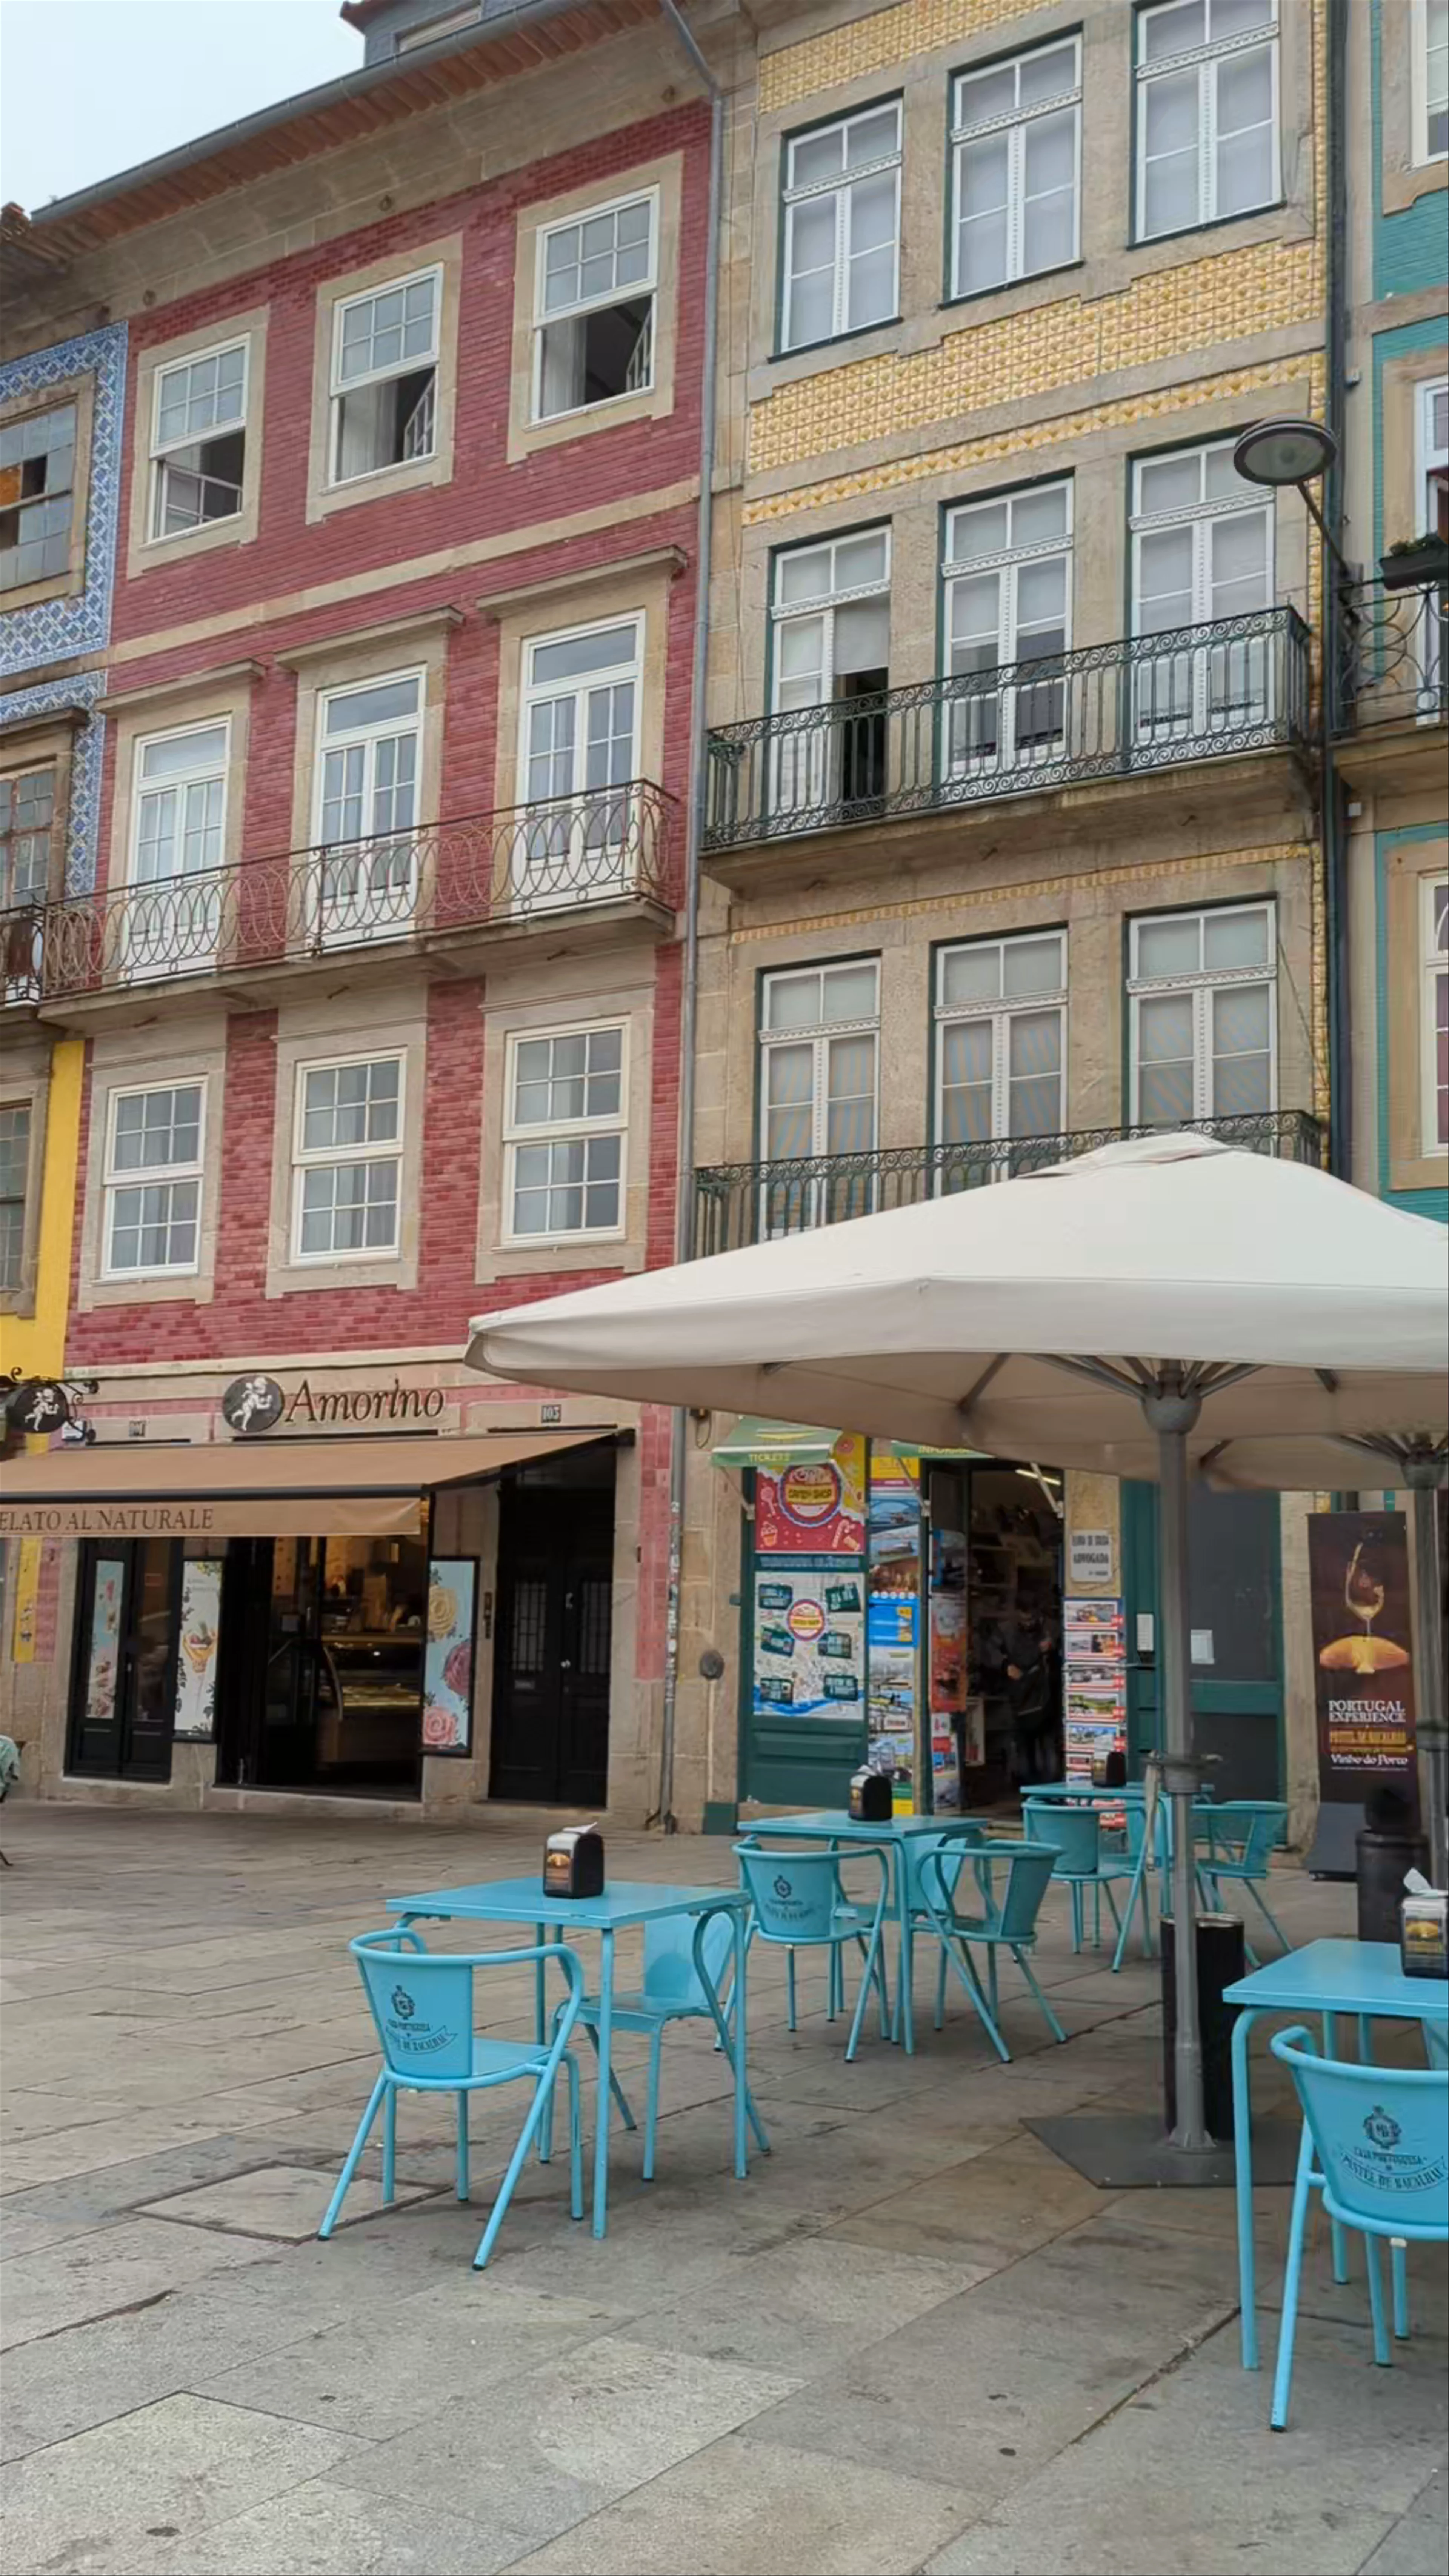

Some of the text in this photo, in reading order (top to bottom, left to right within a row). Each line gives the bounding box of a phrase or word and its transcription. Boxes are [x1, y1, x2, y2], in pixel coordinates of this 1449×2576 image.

[285, 1378, 444, 1422] Amorino
[0, 1509, 213, 1530] ELATO AL NATURALE
[1073, 1552, 1109, 1564] ADVOGADA
[1329, 1701, 1405, 1711] PORTUGAL
[1329, 1712, 1406, 1722] EXPERIENCE
